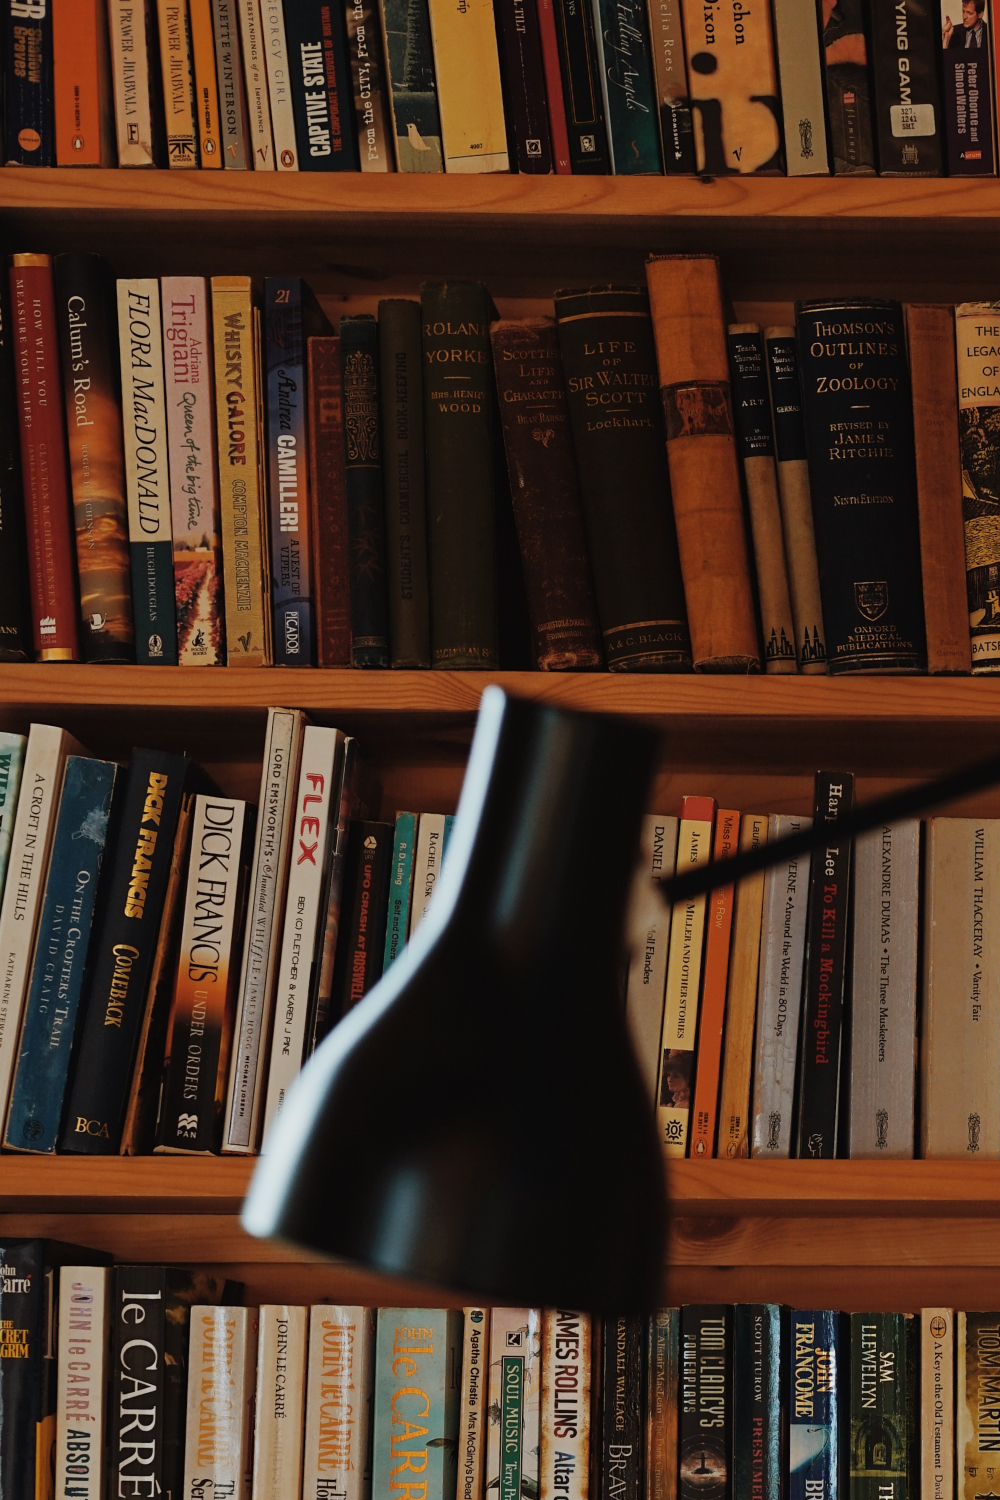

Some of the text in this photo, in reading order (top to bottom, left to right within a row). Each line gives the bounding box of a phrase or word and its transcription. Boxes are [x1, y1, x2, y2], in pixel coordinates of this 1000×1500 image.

[300, 41, 331, 157] CAPTIVE STATE
[954, 63, 966, 134] Simon Walters
[967, 62, 978, 142] Peter Oborne and
[16, 278, 32, 429] MEASURE YOUR LIFE?
[33, 300, 46, 406] HOW WILL YOU
[167, 295, 195, 385] Trigiani
[190, 337, 200, 385] Adriana
[810, 341, 898, 357] OUTLINES
[813, 321, 894, 337] THOMSON'S
[128, 289, 161, 535] FLORA MacDONALD
[816, 376, 899, 393] ZOOLOGY
[277, 369, 297, 532] Andrea CAMILLERI
[828, 447, 894, 459] RITCHIE
[834, 432, 885, 444] JAMES
[149, 579, 157, 621] DOUGLAS
[297, 773, 325, 866] FLEX
[189, 804, 235, 983] DICK FRANCIS
[880, 826, 891, 943] ALEXANDRE DUMAS
[972, 829, 984, 1022] WILLIAM THACKERAY Vanity Fair
[182, 991, 207, 1100] UNDER ORDERS
[75, 1118, 110, 1139] BCA
[118, 1289, 161, 1498] le CARRÉ
[506, 1365, 519, 1453] SOUL MUSIC
